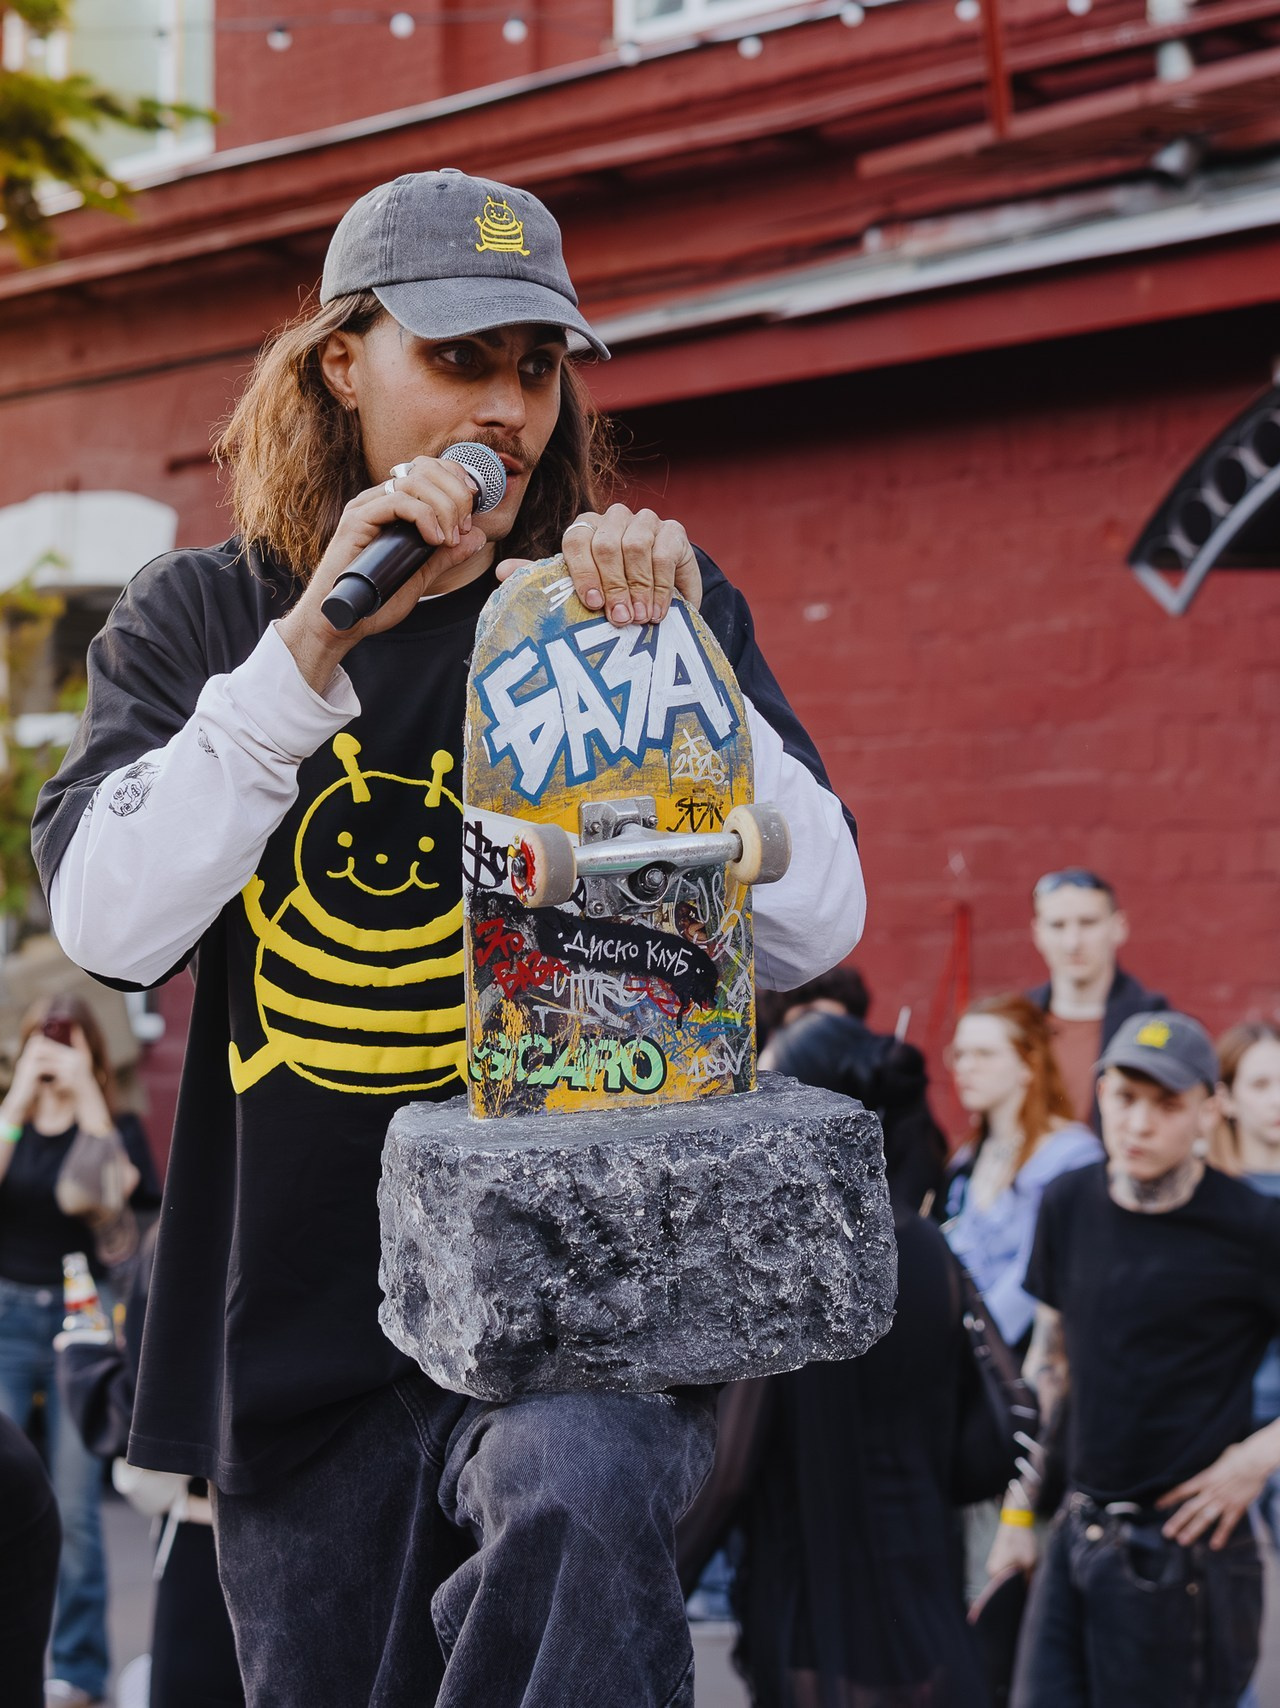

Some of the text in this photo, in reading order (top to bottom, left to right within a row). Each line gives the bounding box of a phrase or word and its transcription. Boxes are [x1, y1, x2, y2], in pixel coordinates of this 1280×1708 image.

[475, 600, 740, 805] БАЗА
[562, 930, 639, 964] ДИСКО
[491, 950, 571, 1000] БАЗА
